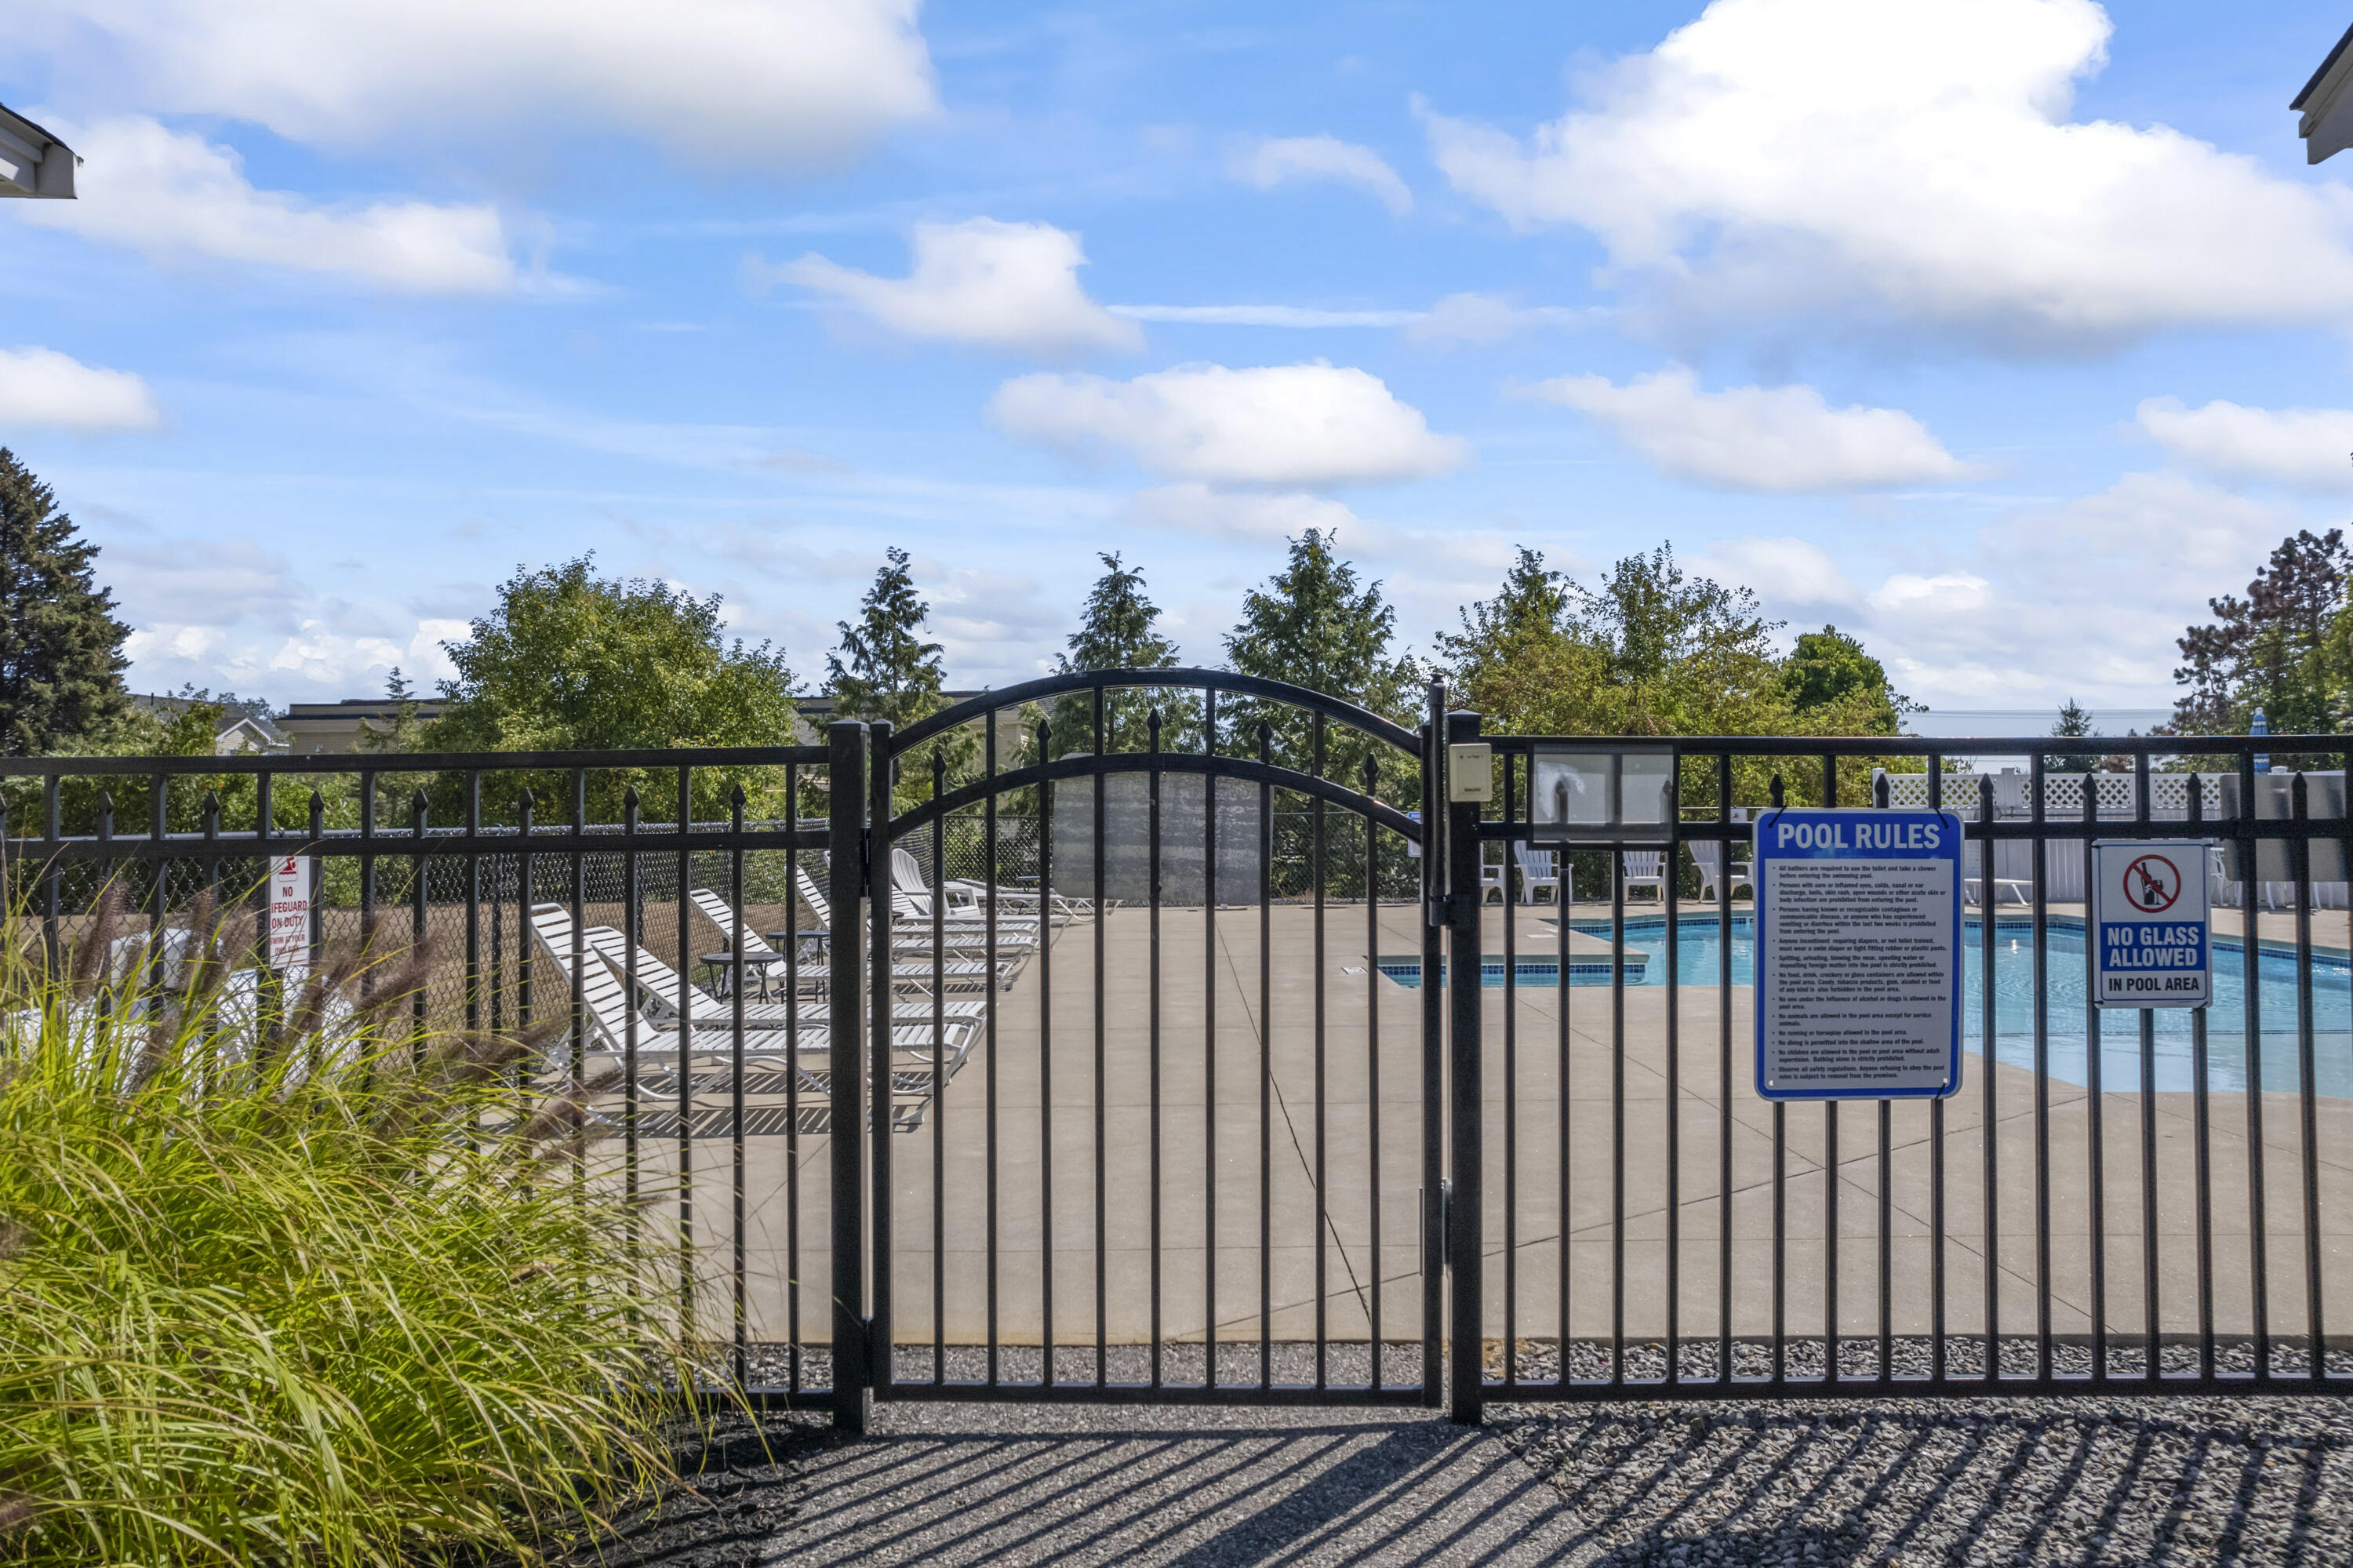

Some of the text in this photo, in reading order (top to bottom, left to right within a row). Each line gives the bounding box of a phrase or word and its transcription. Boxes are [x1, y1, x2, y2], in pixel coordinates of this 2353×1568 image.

[1778, 824, 1940, 849] POOL RULES
[282, 886, 293, 897] NO
[270, 900, 307, 913] IFEGUARD
[271, 915, 304, 929] ON DUTY
[270, 937, 284, 945] SWIM
[2108, 926, 2199, 946] NO GLASS
[2109, 948, 2198, 967] ALLOWED
[2108, 977, 2199, 991] IN POOL AREA
